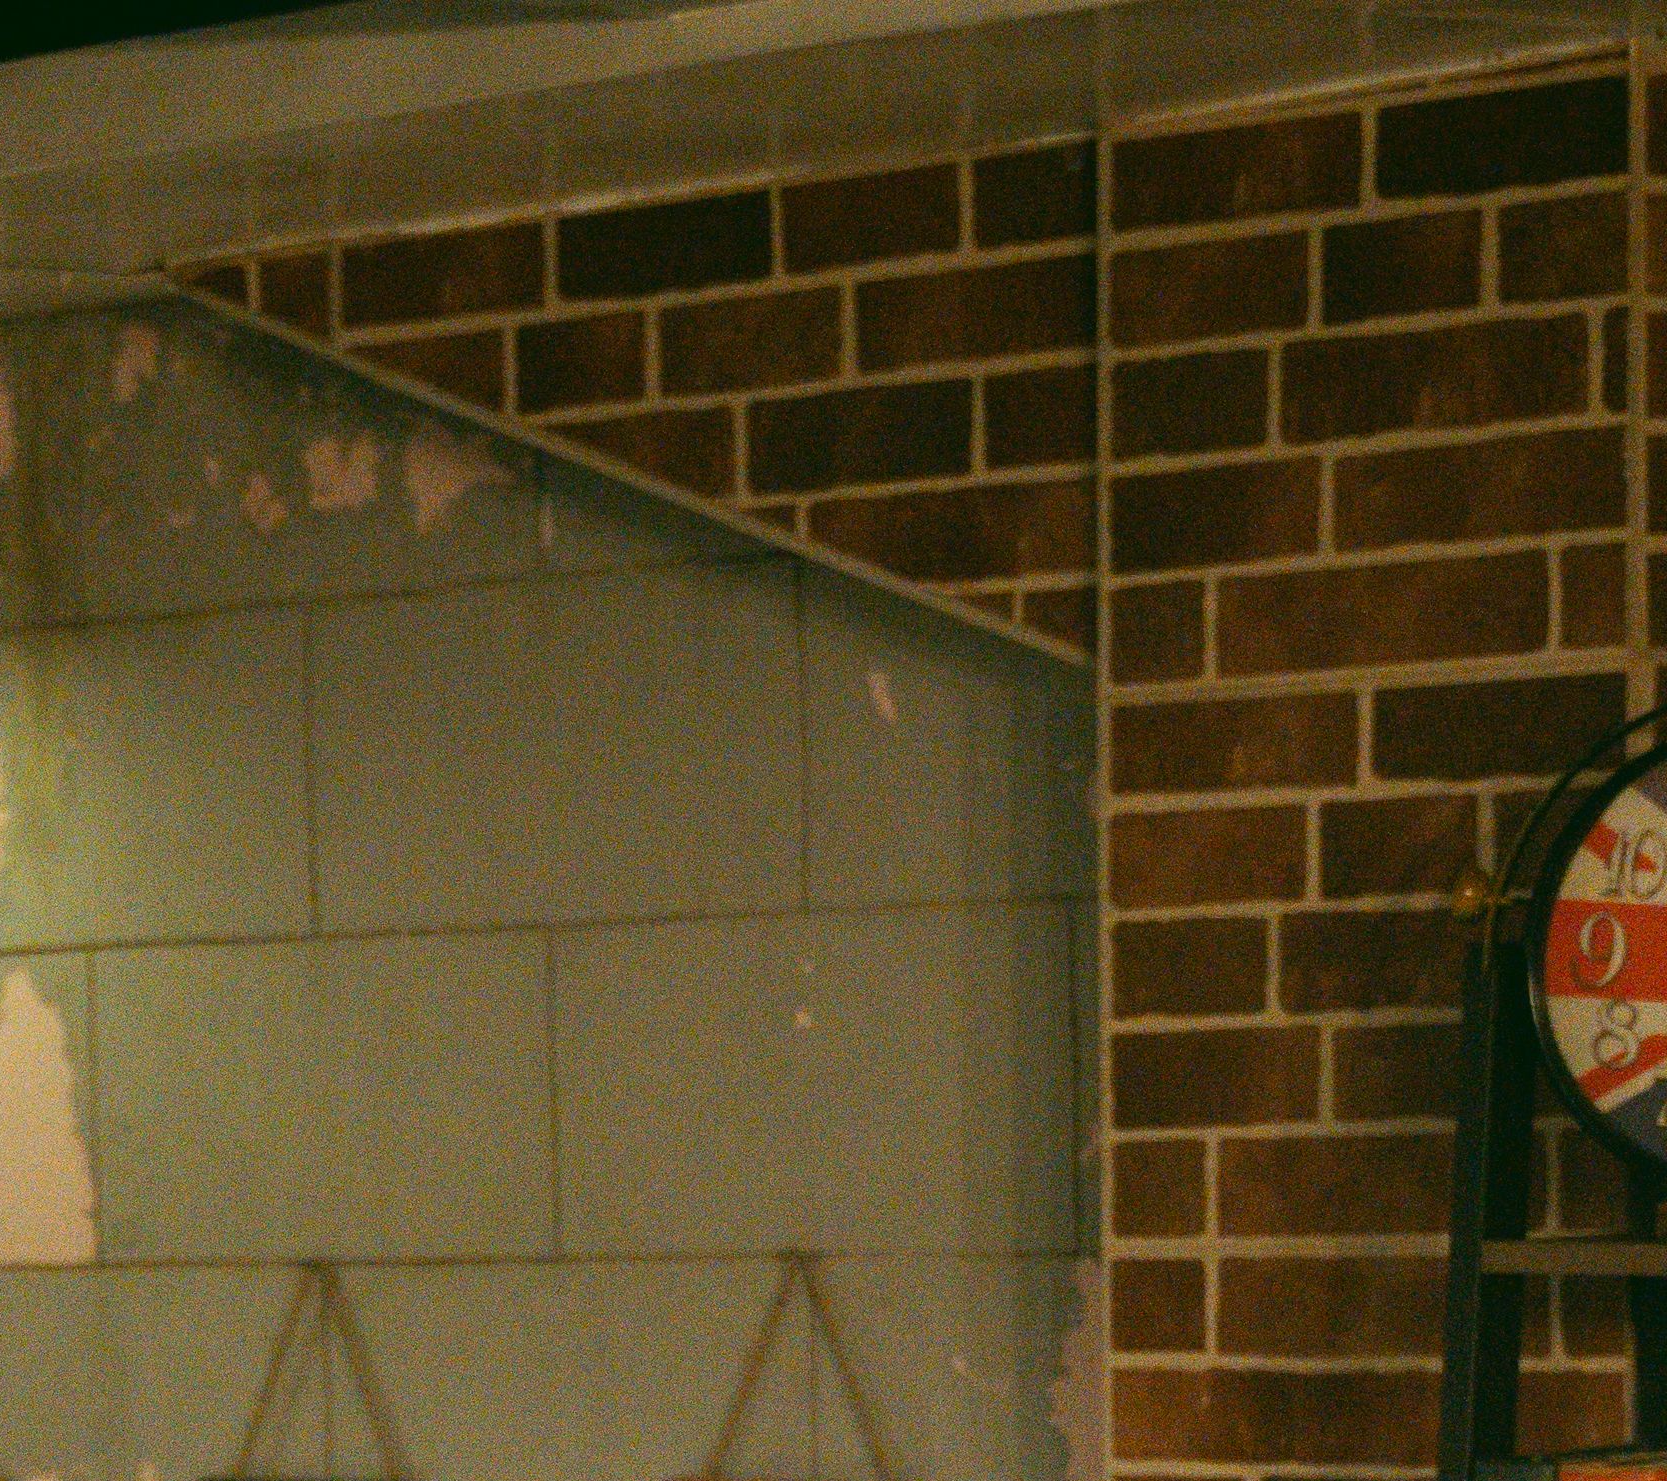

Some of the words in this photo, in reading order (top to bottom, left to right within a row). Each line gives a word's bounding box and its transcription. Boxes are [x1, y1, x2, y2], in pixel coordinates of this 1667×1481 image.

[1603, 829, 1667, 899] 10
[1571, 911, 1628, 989] 9
[1592, 1002, 1640, 1070] 8
